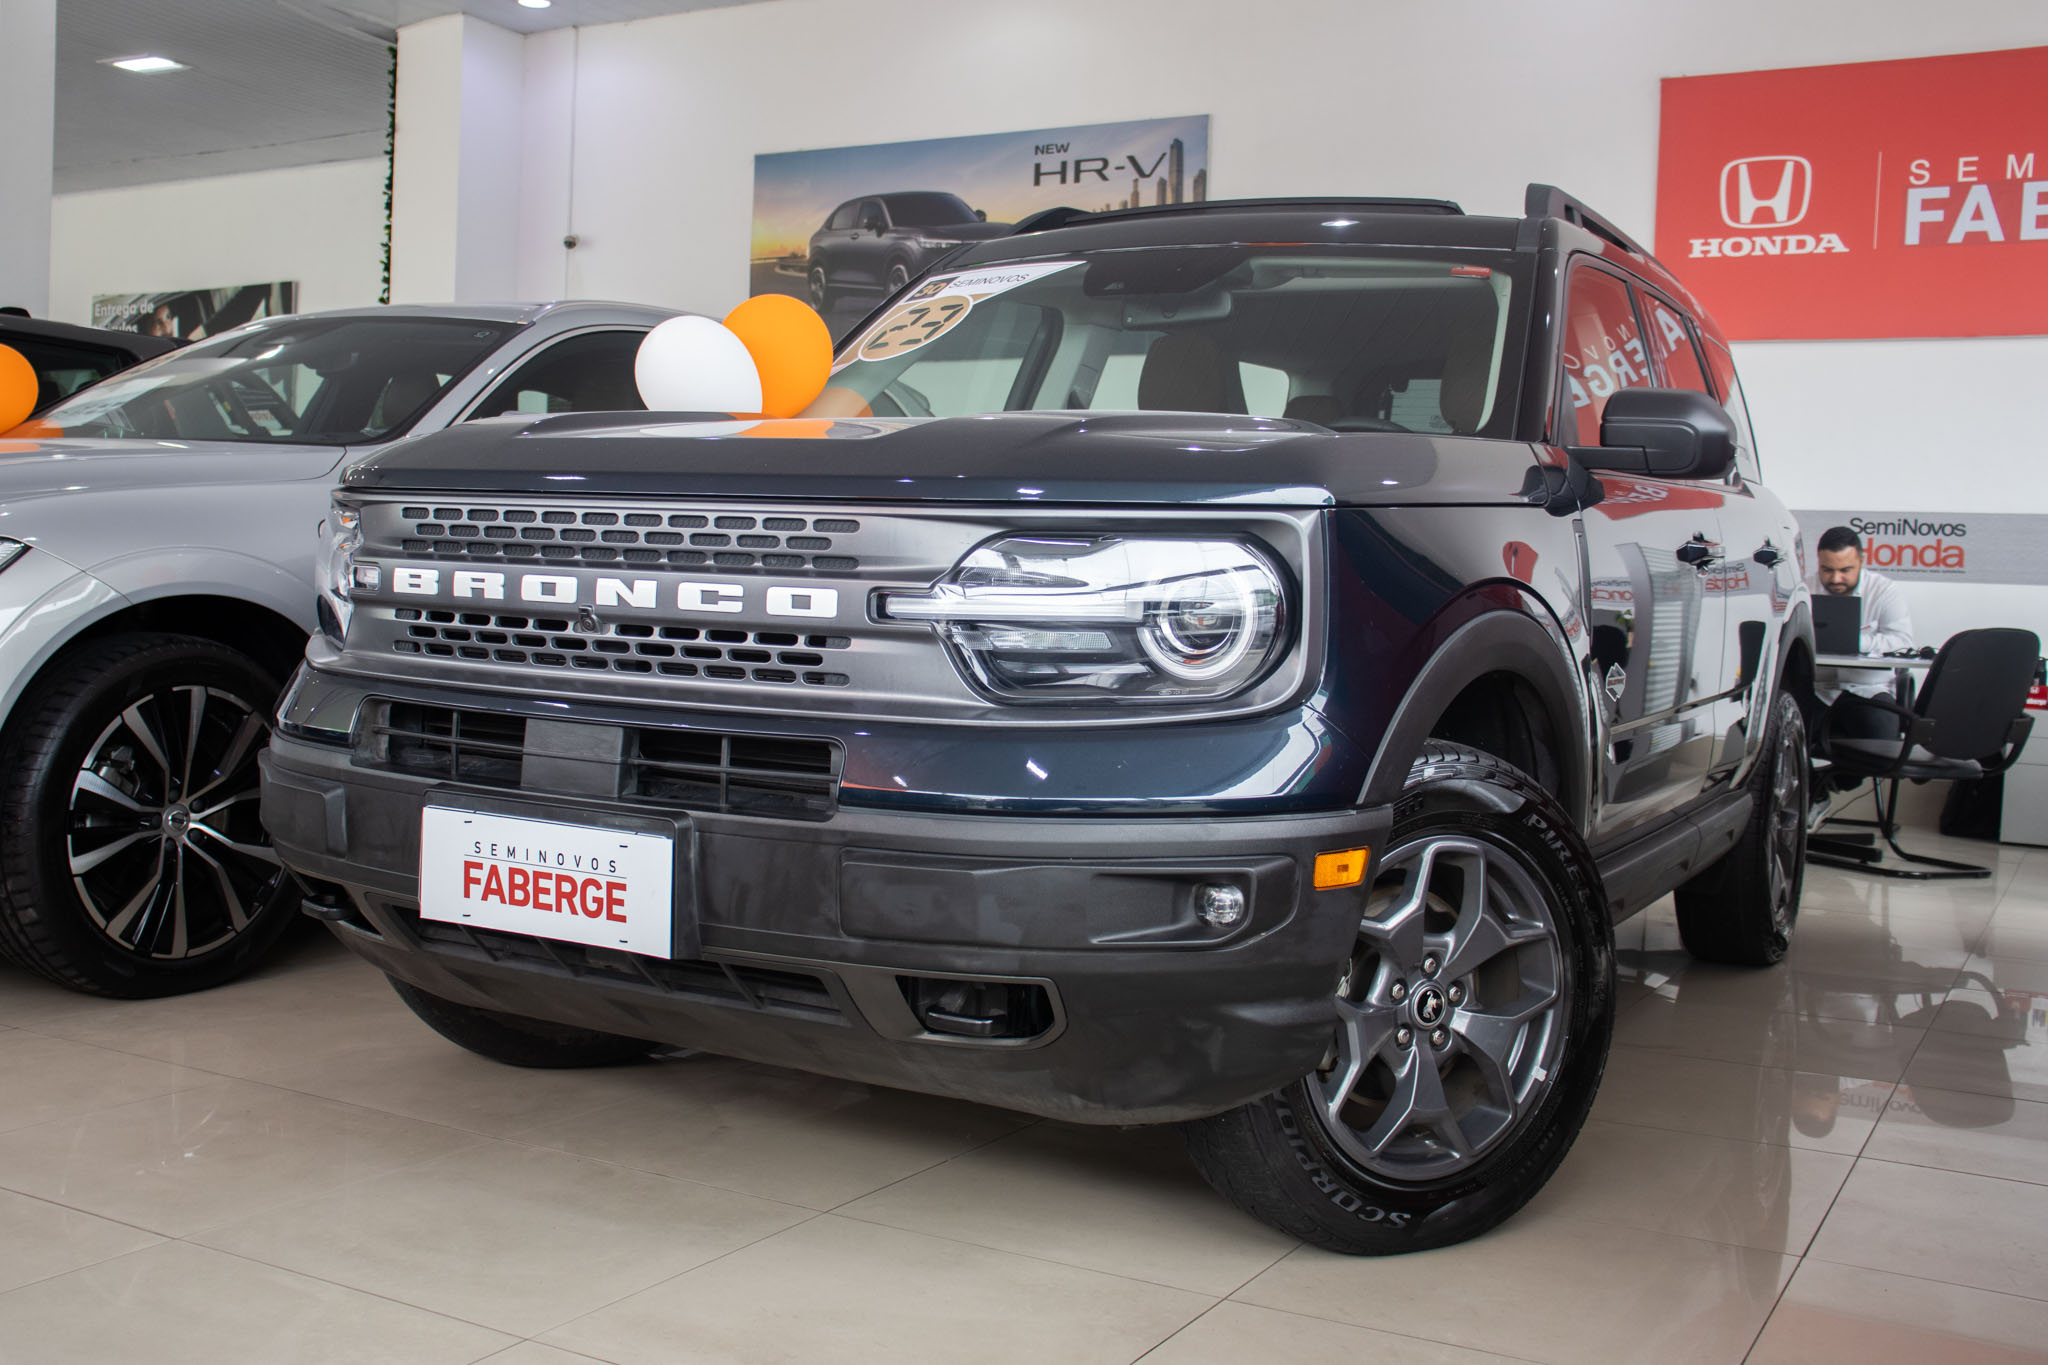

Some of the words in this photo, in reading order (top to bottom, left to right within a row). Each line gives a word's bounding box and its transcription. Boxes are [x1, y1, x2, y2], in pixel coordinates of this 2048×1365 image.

[1034, 142, 1070, 155] NEW
[1033, 152, 1167, 187] HR-V
[1688, 233, 1850, 259] HONDA
[947, 273, 1030, 289] SEMINOVOS
[94, 303, 137, 319] Entrega
[140, 299, 154, 314] de
[1849, 517, 1967, 537] SemiNovos
[1862, 537, 1965, 569] Honda
[393, 567, 839, 618] BRONCO
[474, 841, 617, 873] SEMINOVOS
[463, 860, 628, 924] FABERGE
